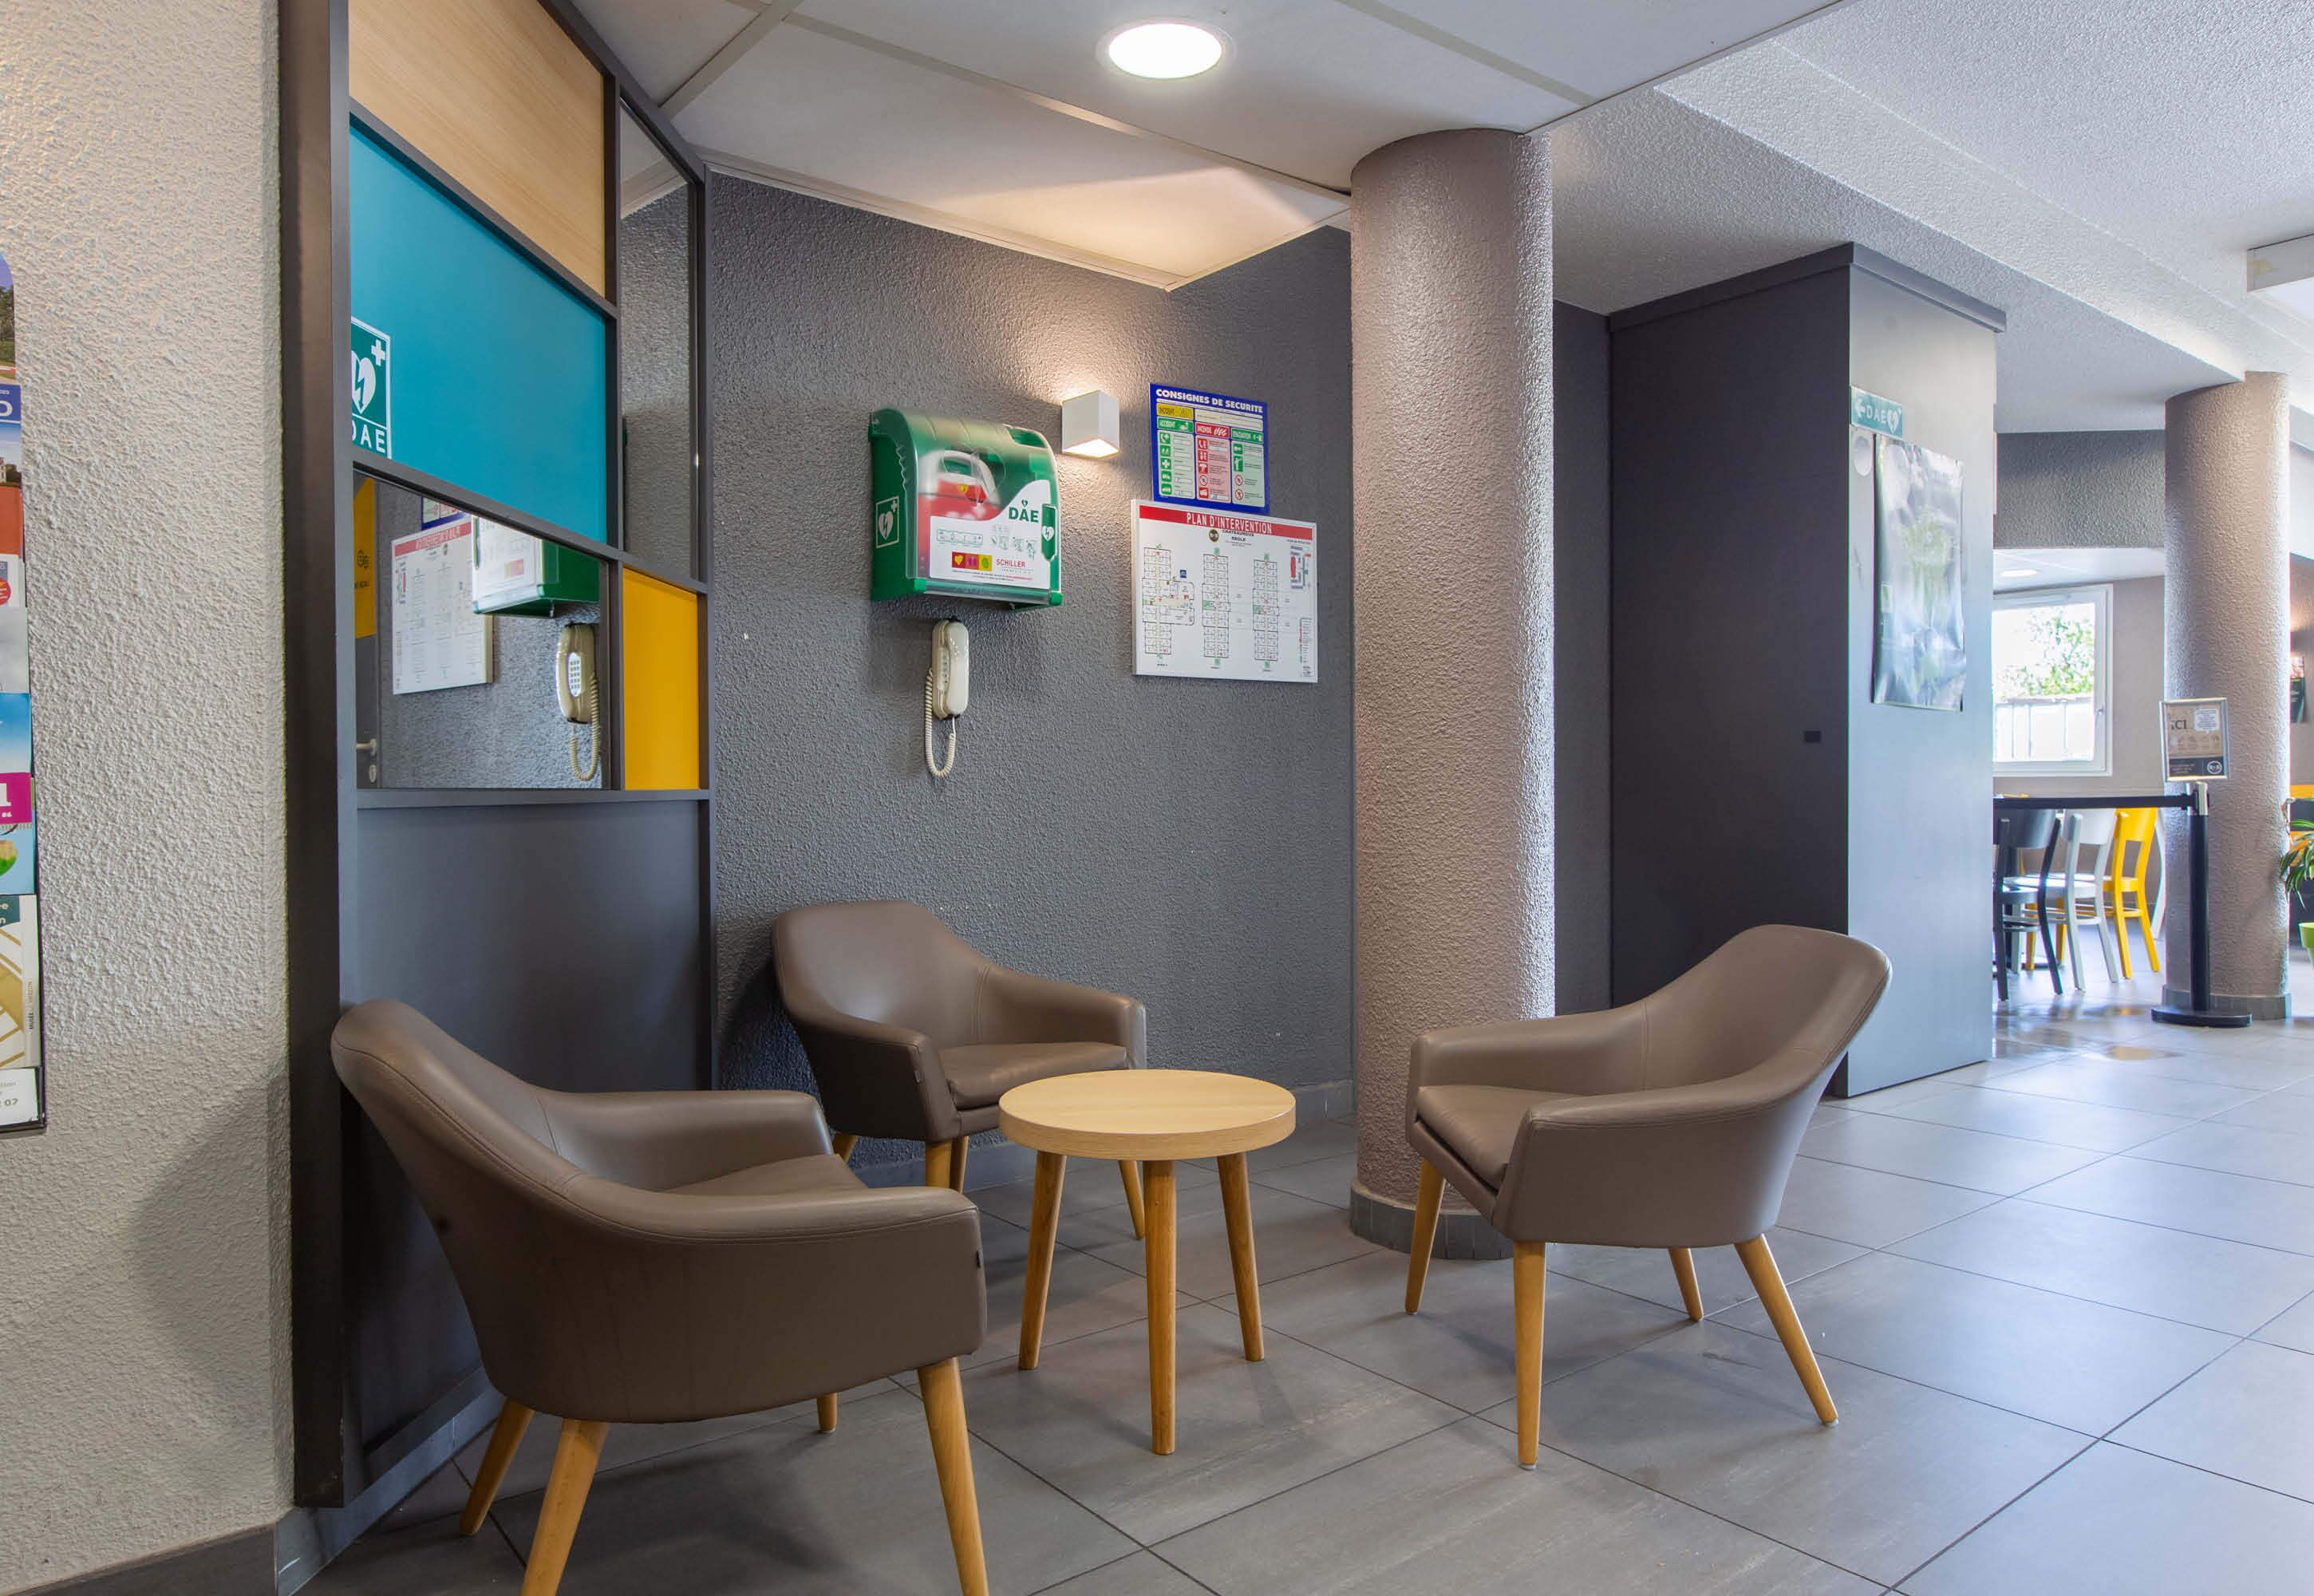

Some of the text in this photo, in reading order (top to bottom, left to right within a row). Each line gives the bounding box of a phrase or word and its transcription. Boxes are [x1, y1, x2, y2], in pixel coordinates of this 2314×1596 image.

[1155, 389, 1210, 404] CONSIGNES
[1225, 400, 1263, 413] SECURITE
[1866, 405, 1886, 424] DAE
[1008, 506, 1039, 523] DAE
[1187, 512, 1273, 534] PLAN D'INTERVENTION
[996, 558, 1026, 567] SCHILLER
